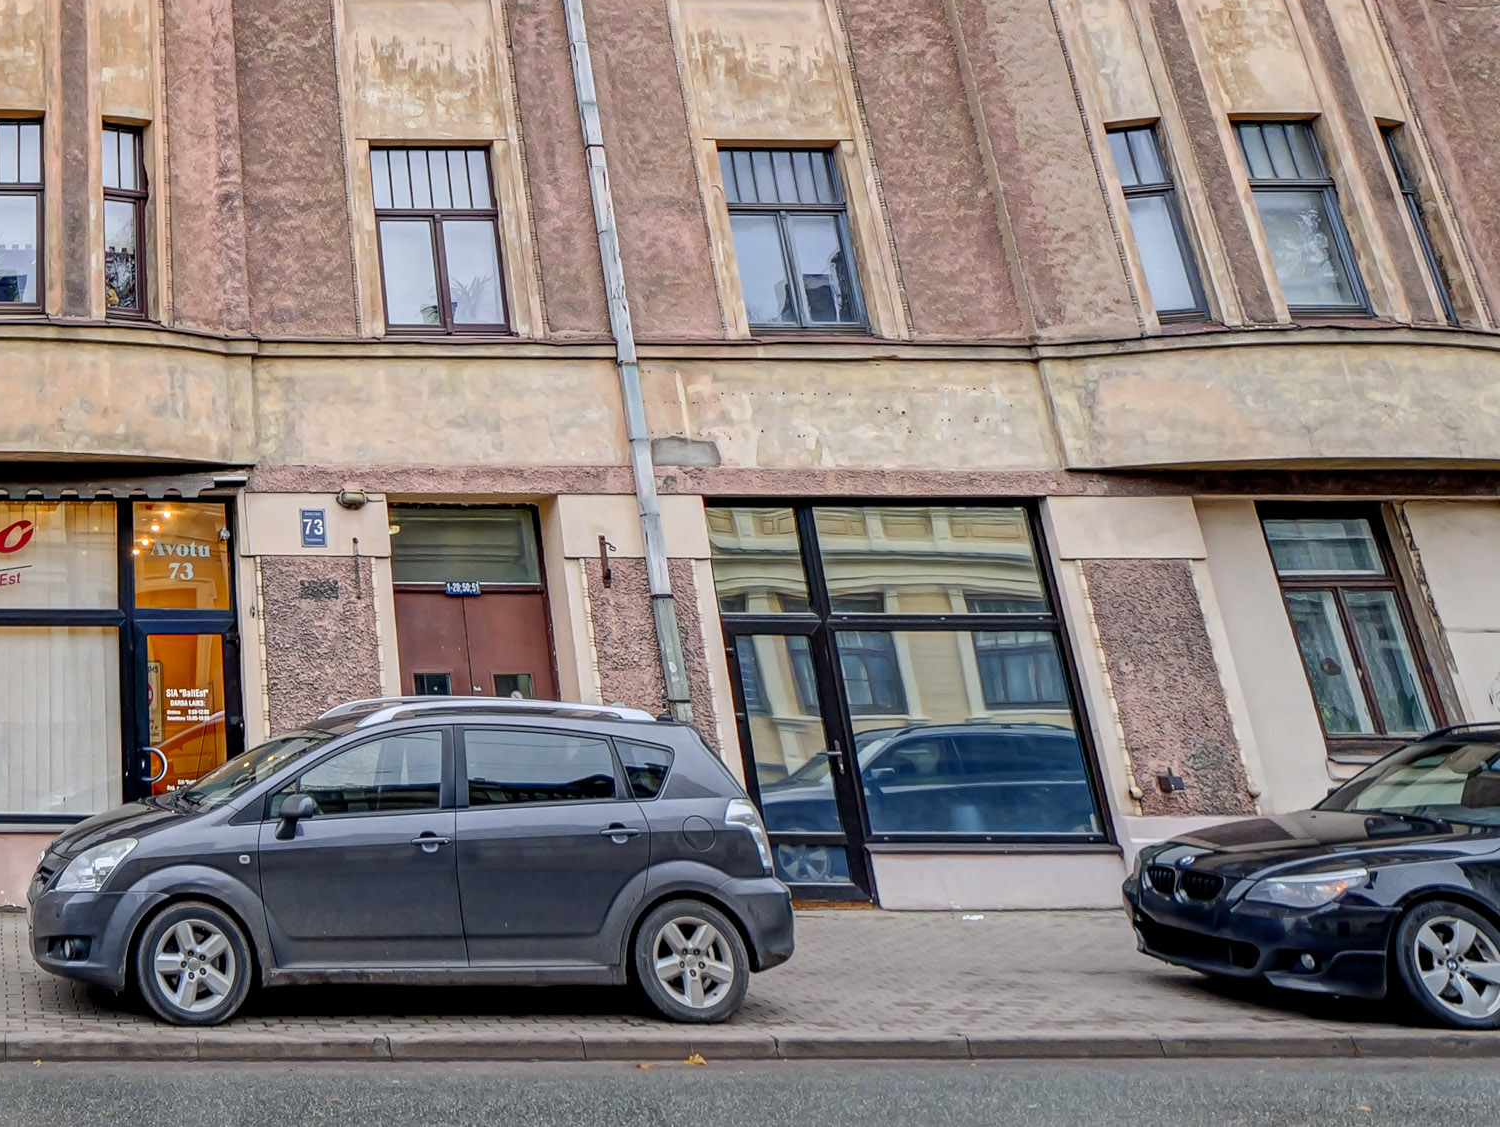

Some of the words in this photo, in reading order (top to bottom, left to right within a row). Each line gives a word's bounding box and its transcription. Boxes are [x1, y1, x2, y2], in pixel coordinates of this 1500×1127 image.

[303, 519, 324, 535] 73
[150, 539, 211, 558] Avotu
[168, 562, 194, 580] 73
[166, 689, 179, 698] SIA
